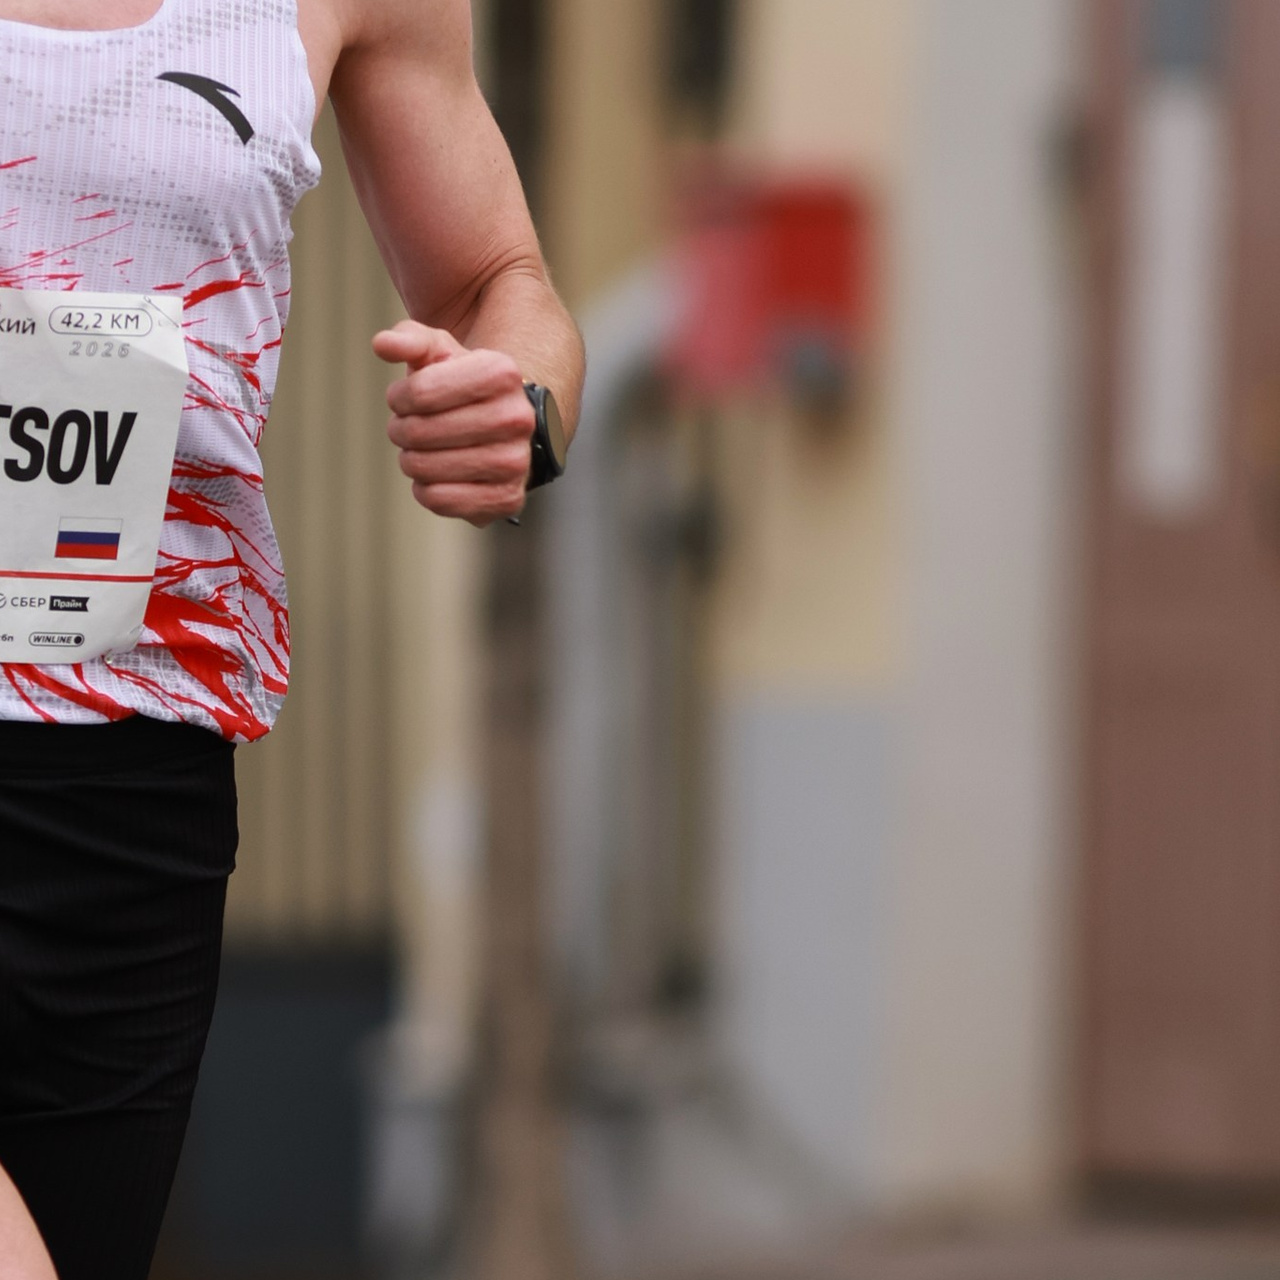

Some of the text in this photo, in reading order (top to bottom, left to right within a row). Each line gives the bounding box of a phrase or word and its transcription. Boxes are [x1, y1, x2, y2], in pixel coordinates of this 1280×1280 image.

[60, 312, 103, 332] 42,2
[10, 596, 83, 609] СБЕР Прайм
[33, 634, 73, 645] WINLINE
